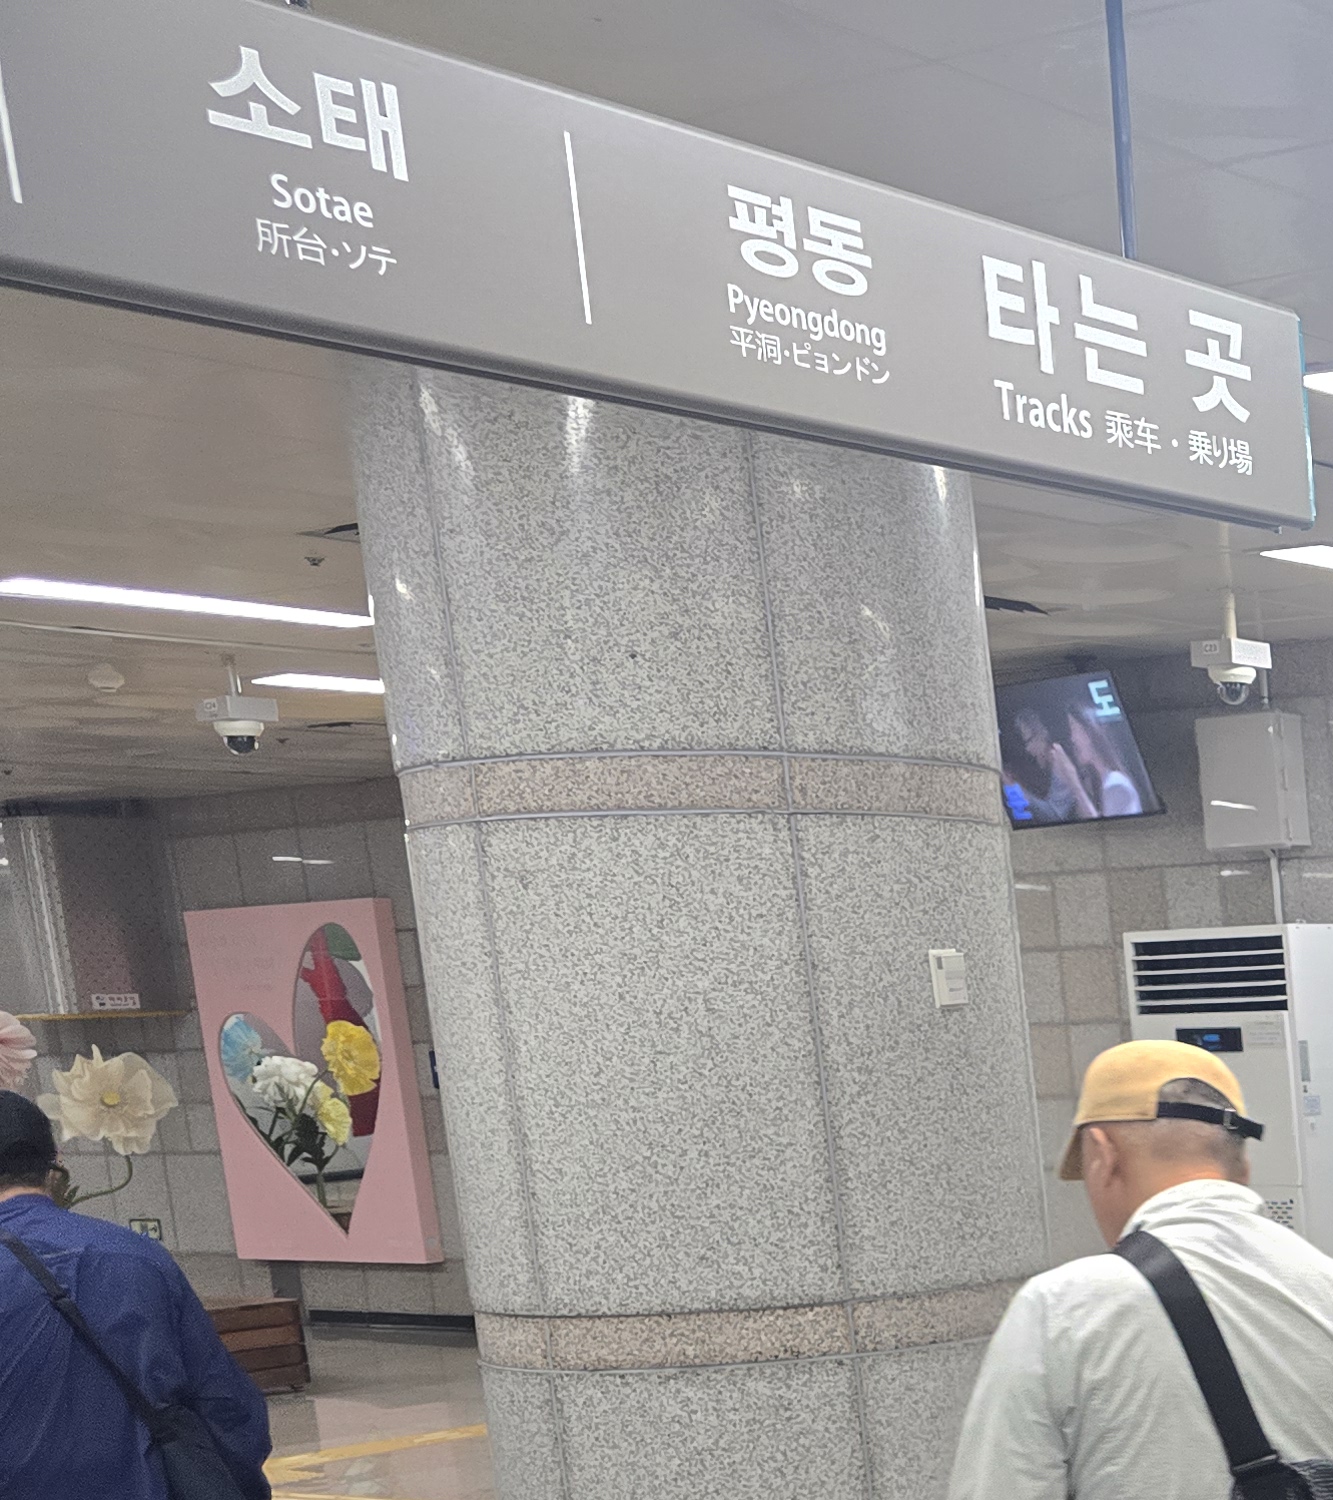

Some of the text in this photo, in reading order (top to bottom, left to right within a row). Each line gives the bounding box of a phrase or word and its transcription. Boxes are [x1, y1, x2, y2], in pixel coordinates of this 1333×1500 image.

[208, 46, 408, 181] 소태
[271, 173, 374, 228] Sotae
[727, 184, 873, 297] 평동
[727, 283, 886, 357] Pyeongdong
[982, 254, 1252, 423] 타는 곳
[994, 379, 1093, 439] Tracks
